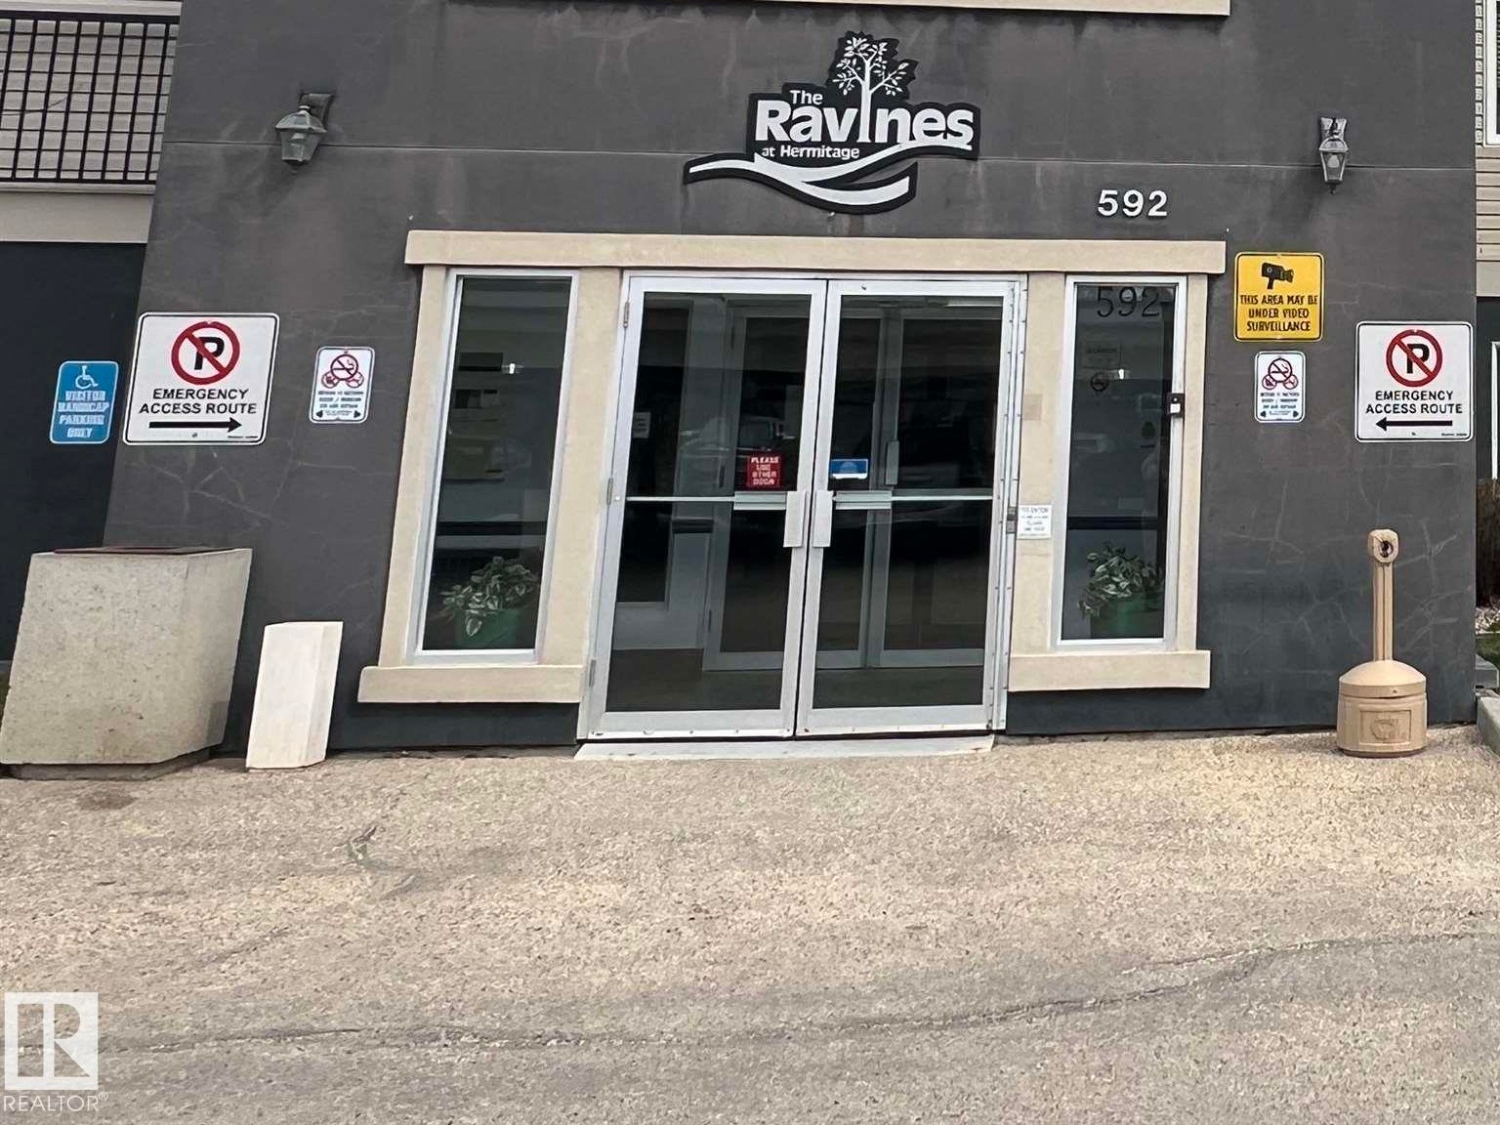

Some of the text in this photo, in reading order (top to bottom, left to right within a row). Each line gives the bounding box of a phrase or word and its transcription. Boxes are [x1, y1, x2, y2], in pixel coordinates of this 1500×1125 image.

[789, 89, 824, 106] The
[755, 99, 975, 145] Ravines
[760, 144, 860, 160] at Hermitage
[1097, 189, 1168, 217] 592
[1096, 286, 1160, 318] 592
[1240, 295, 1318, 305] THIS AREA MAY BE
[1248, 308, 1310, 318] UNDER VIDEO
[1246, 321, 1311, 332] SURVEILLANCE
[152, 388, 249, 400] EMERGENCY
[1375, 390, 1454, 401] EMERGENCY
[139, 403, 257, 414] ACCESS ROUTE
[1365, 403, 1463, 414] ACCESS ROUTE
